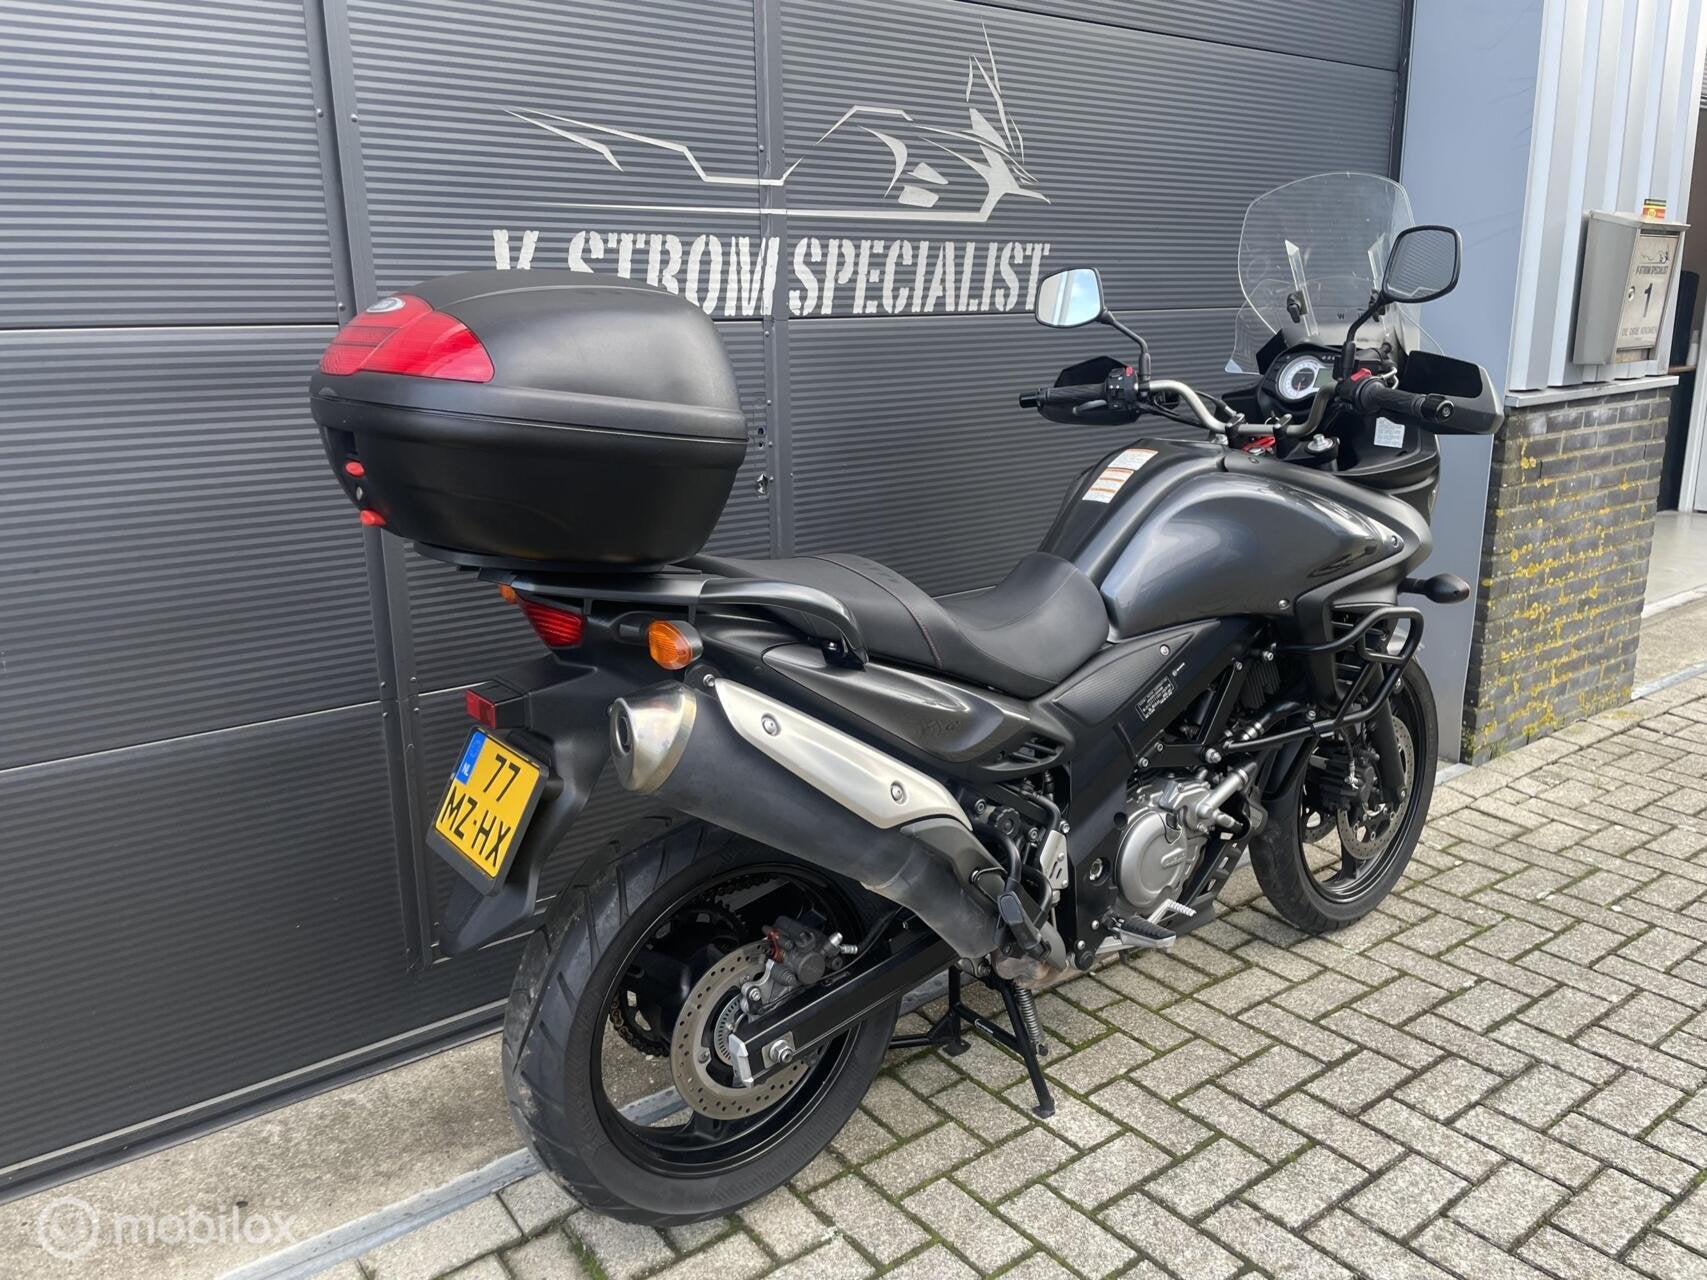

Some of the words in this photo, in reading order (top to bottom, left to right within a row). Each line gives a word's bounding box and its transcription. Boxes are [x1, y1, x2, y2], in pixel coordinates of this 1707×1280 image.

[788, 236, 1052, 316] SPECIALIST
[1644, 282, 1653, 318] 1
[483, 753, 521, 802] 77
[440, 785, 511, 868] MZ-HX
